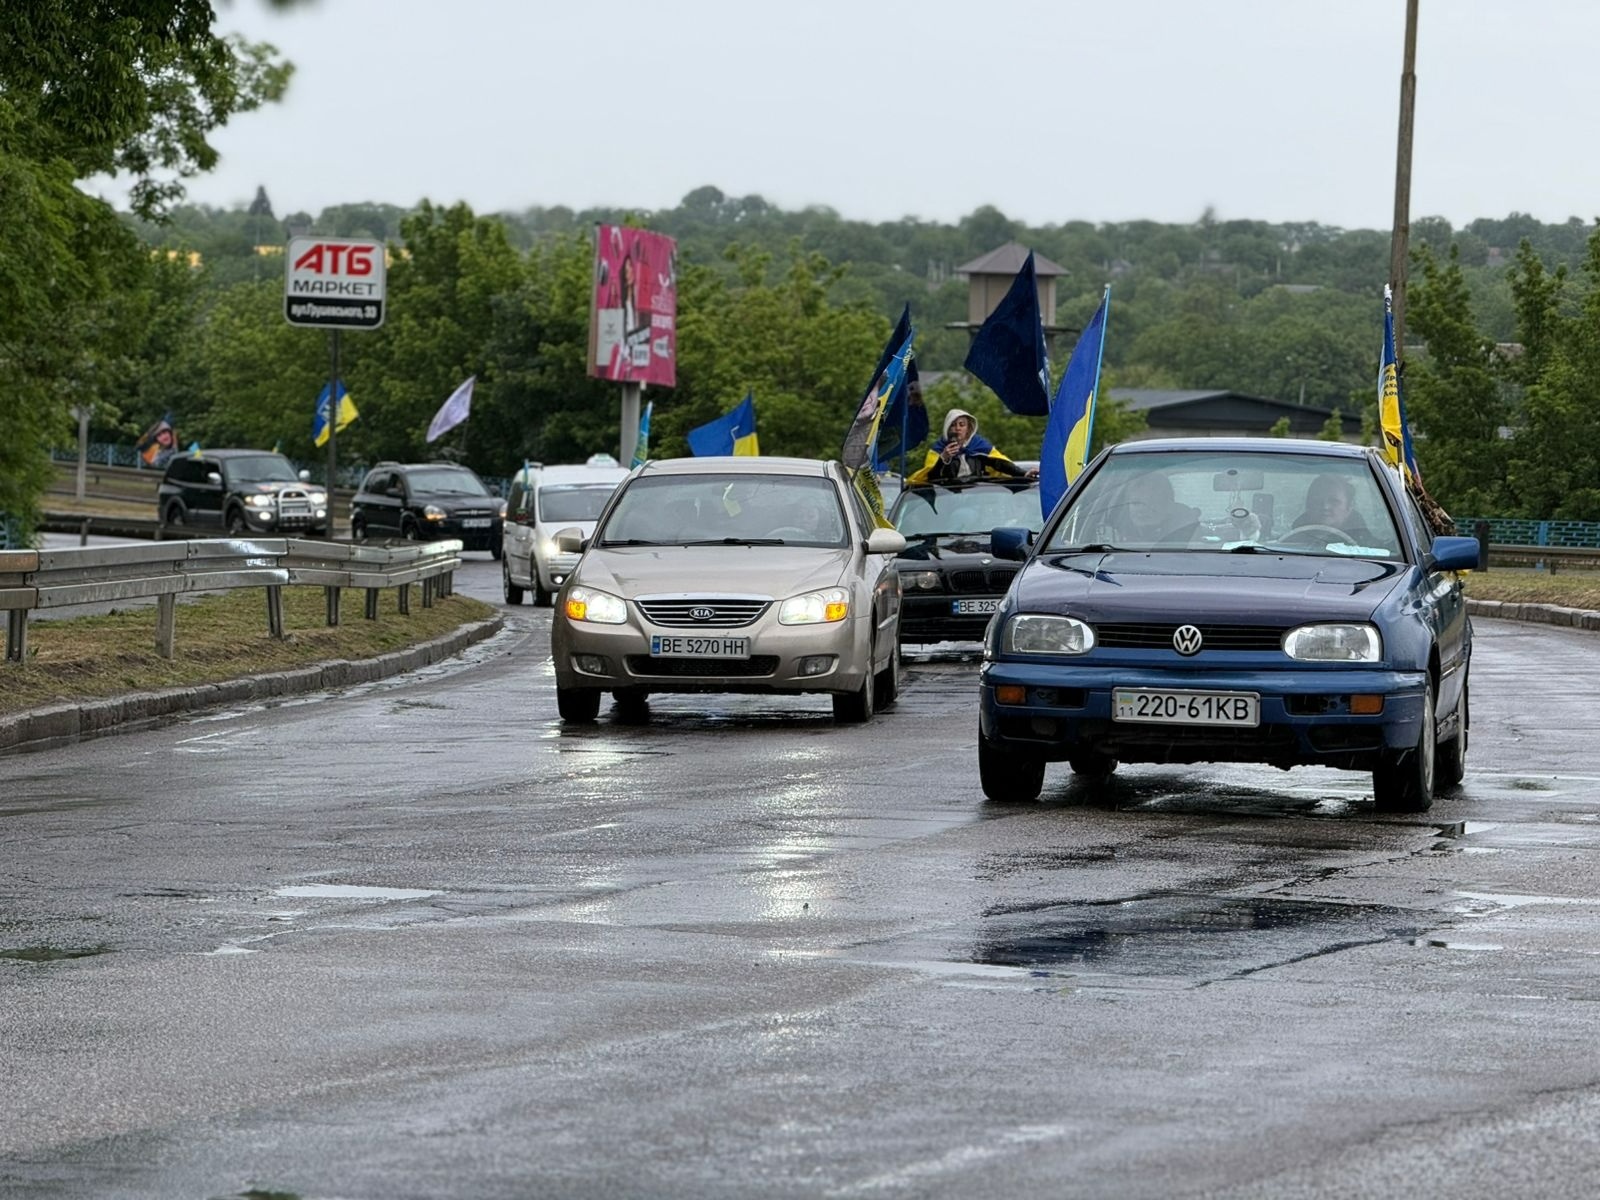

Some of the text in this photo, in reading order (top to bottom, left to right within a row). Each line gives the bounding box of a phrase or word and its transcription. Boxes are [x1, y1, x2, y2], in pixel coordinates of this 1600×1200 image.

[294, 244, 375, 276] АТБ
[293, 280, 377, 295] МАРКЕТ
[693, 608, 711, 617] KIA
[959, 601, 1000, 612] BE 325
[662, 638, 744, 655] BE 5270 HH
